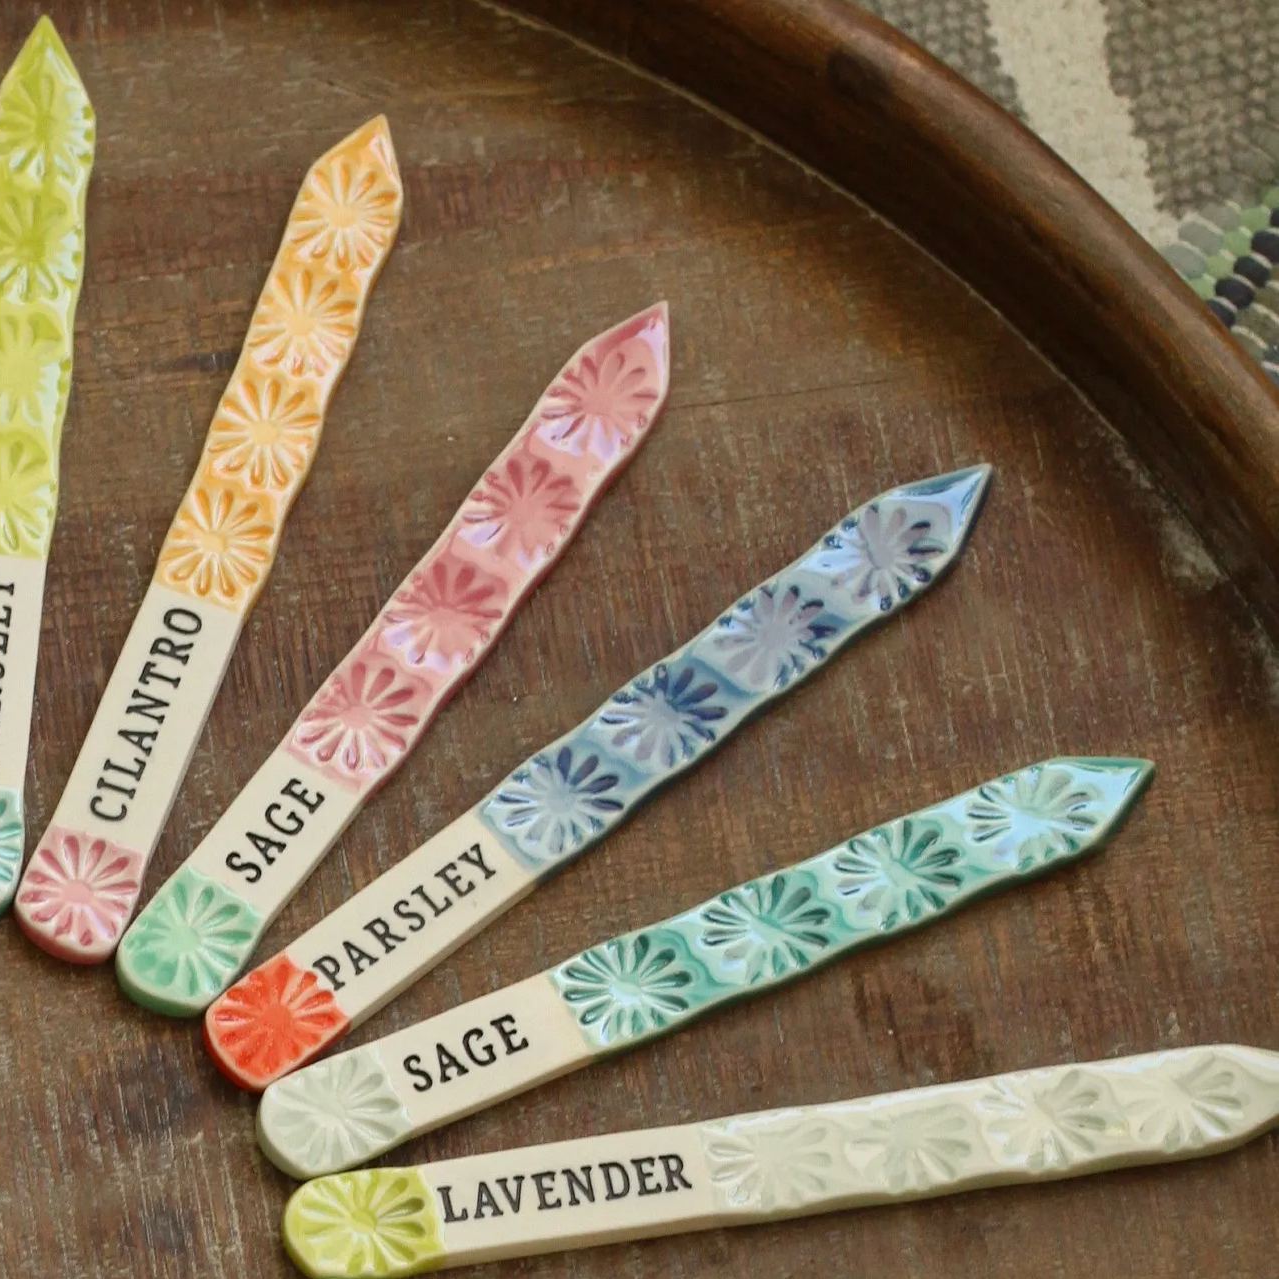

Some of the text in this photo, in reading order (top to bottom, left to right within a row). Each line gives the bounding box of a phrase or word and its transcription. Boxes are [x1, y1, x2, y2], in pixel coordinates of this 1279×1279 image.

[89, 608, 203, 822] CILANTRO
[225, 778, 325, 884] SAGE
[312, 843, 497, 991] PARSLEY
[403, 1014, 529, 1092] SAGE
[436, 1153, 693, 1223] LAVENDER
